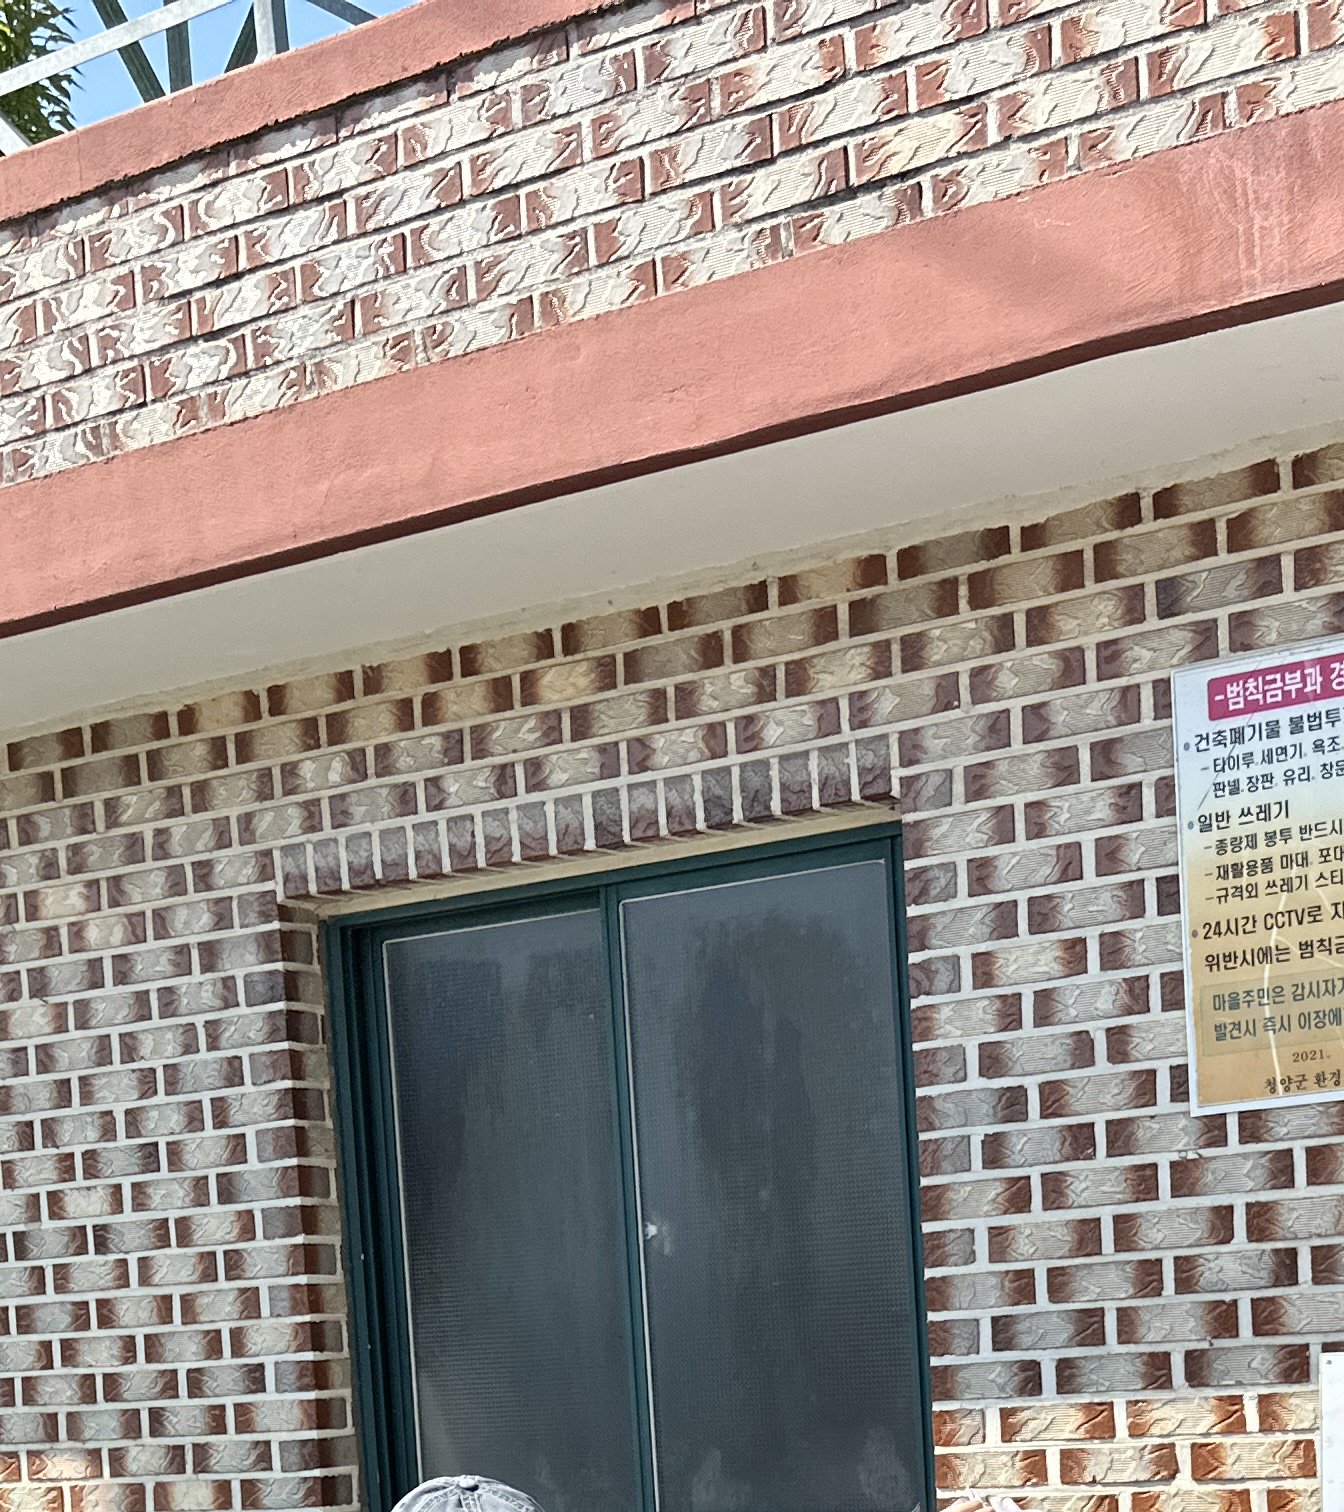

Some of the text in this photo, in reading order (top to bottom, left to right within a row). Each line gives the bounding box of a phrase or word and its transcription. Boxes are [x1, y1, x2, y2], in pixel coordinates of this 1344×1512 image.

[1194, 719, 1281, 753] 건축폐기물
[1197, 800, 1289, 833] 일반 쓰레기
[1264, 828, 1293, 848] 봉투
[1299, 818, 1343, 841] 반드시
[1264, 875, 1309, 896] 쓰레기
[1203, 915, 1257, 940] 24시간
[1264, 905, 1323, 931] CCTV로
[1204, 945, 1290, 972] 위반시에는
[1213, 985, 1285, 1012] 마을주민은
[1214, 1019, 1256, 1041] 발견시
[1262, 1014, 1291, 1035] 즉시
[1264, 1075, 1308, 1094] 청양군
